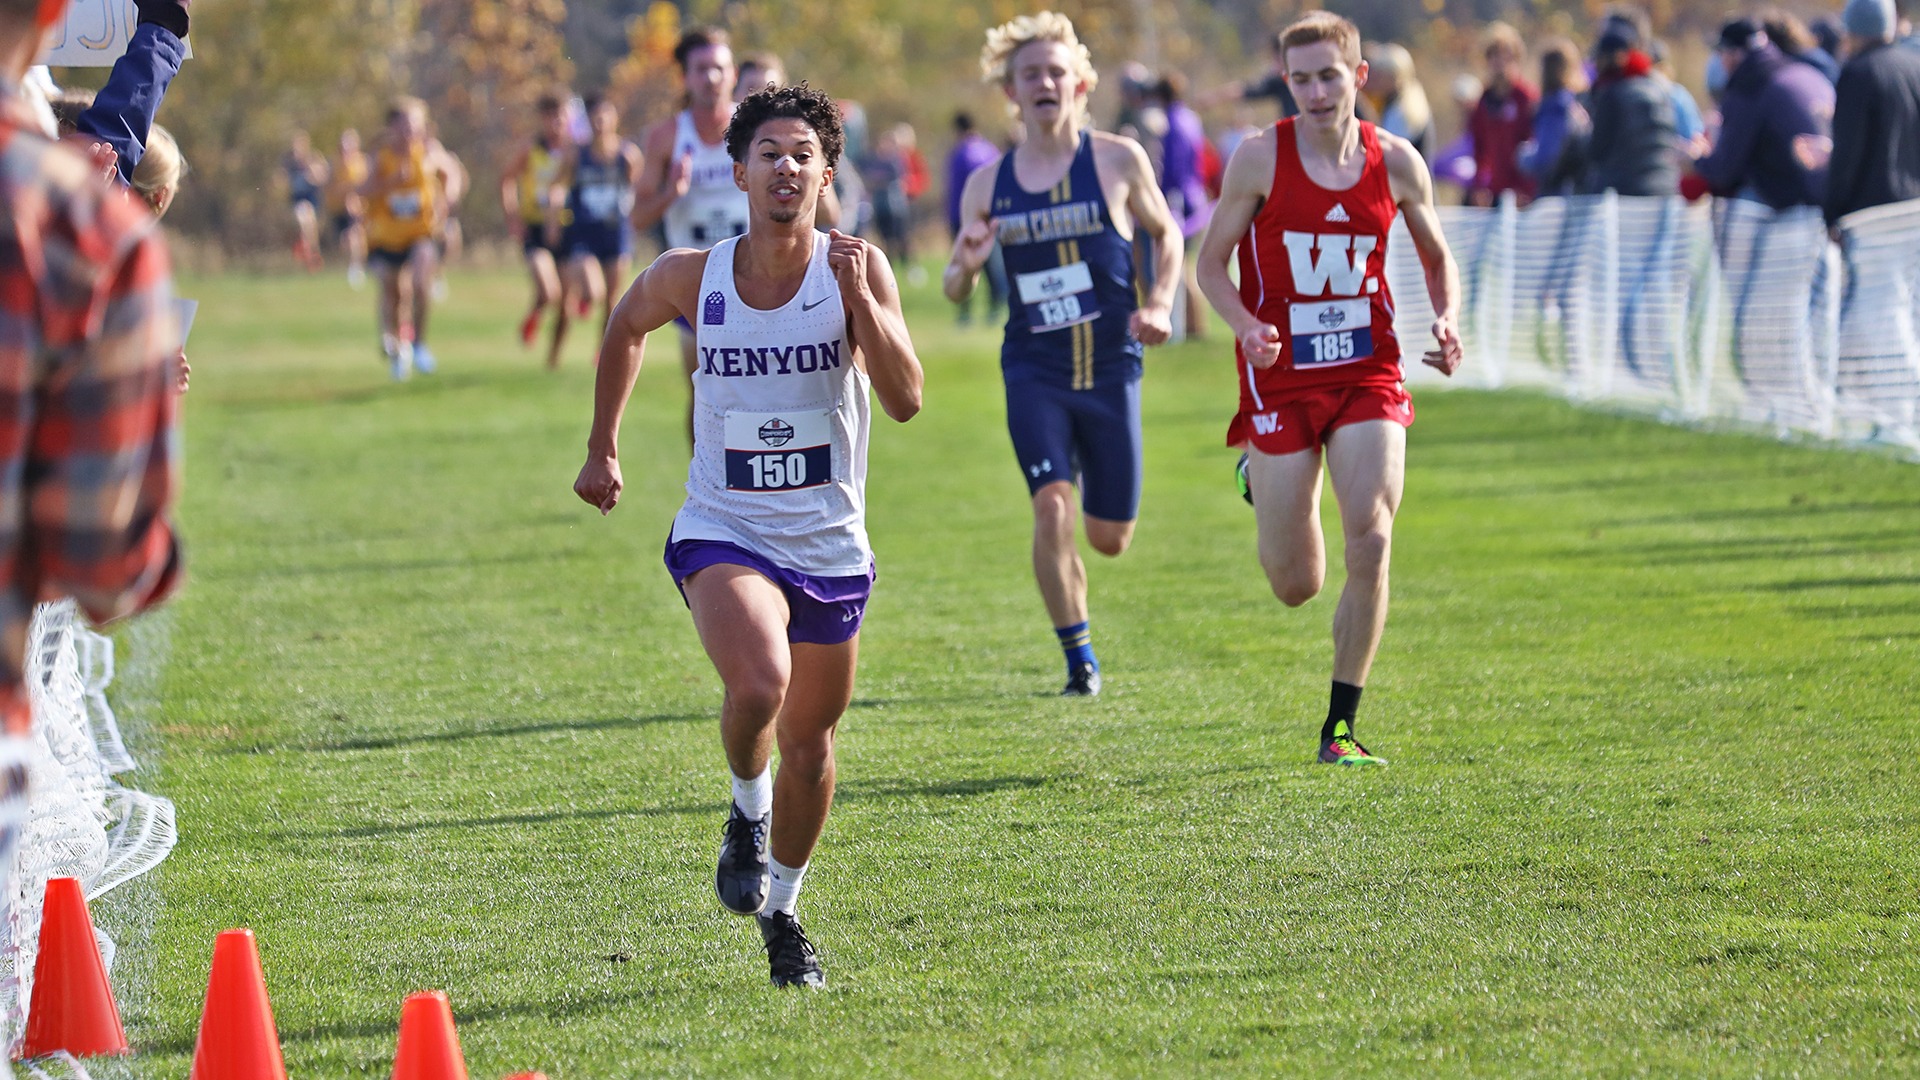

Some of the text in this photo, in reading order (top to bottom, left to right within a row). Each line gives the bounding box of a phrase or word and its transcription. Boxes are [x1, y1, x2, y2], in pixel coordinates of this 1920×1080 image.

[1040, 295, 1081, 327] 139
[702, 339, 840, 377] KENYON
[1311, 332, 1354, 362] 185
[747, 452, 806, 488] 150
